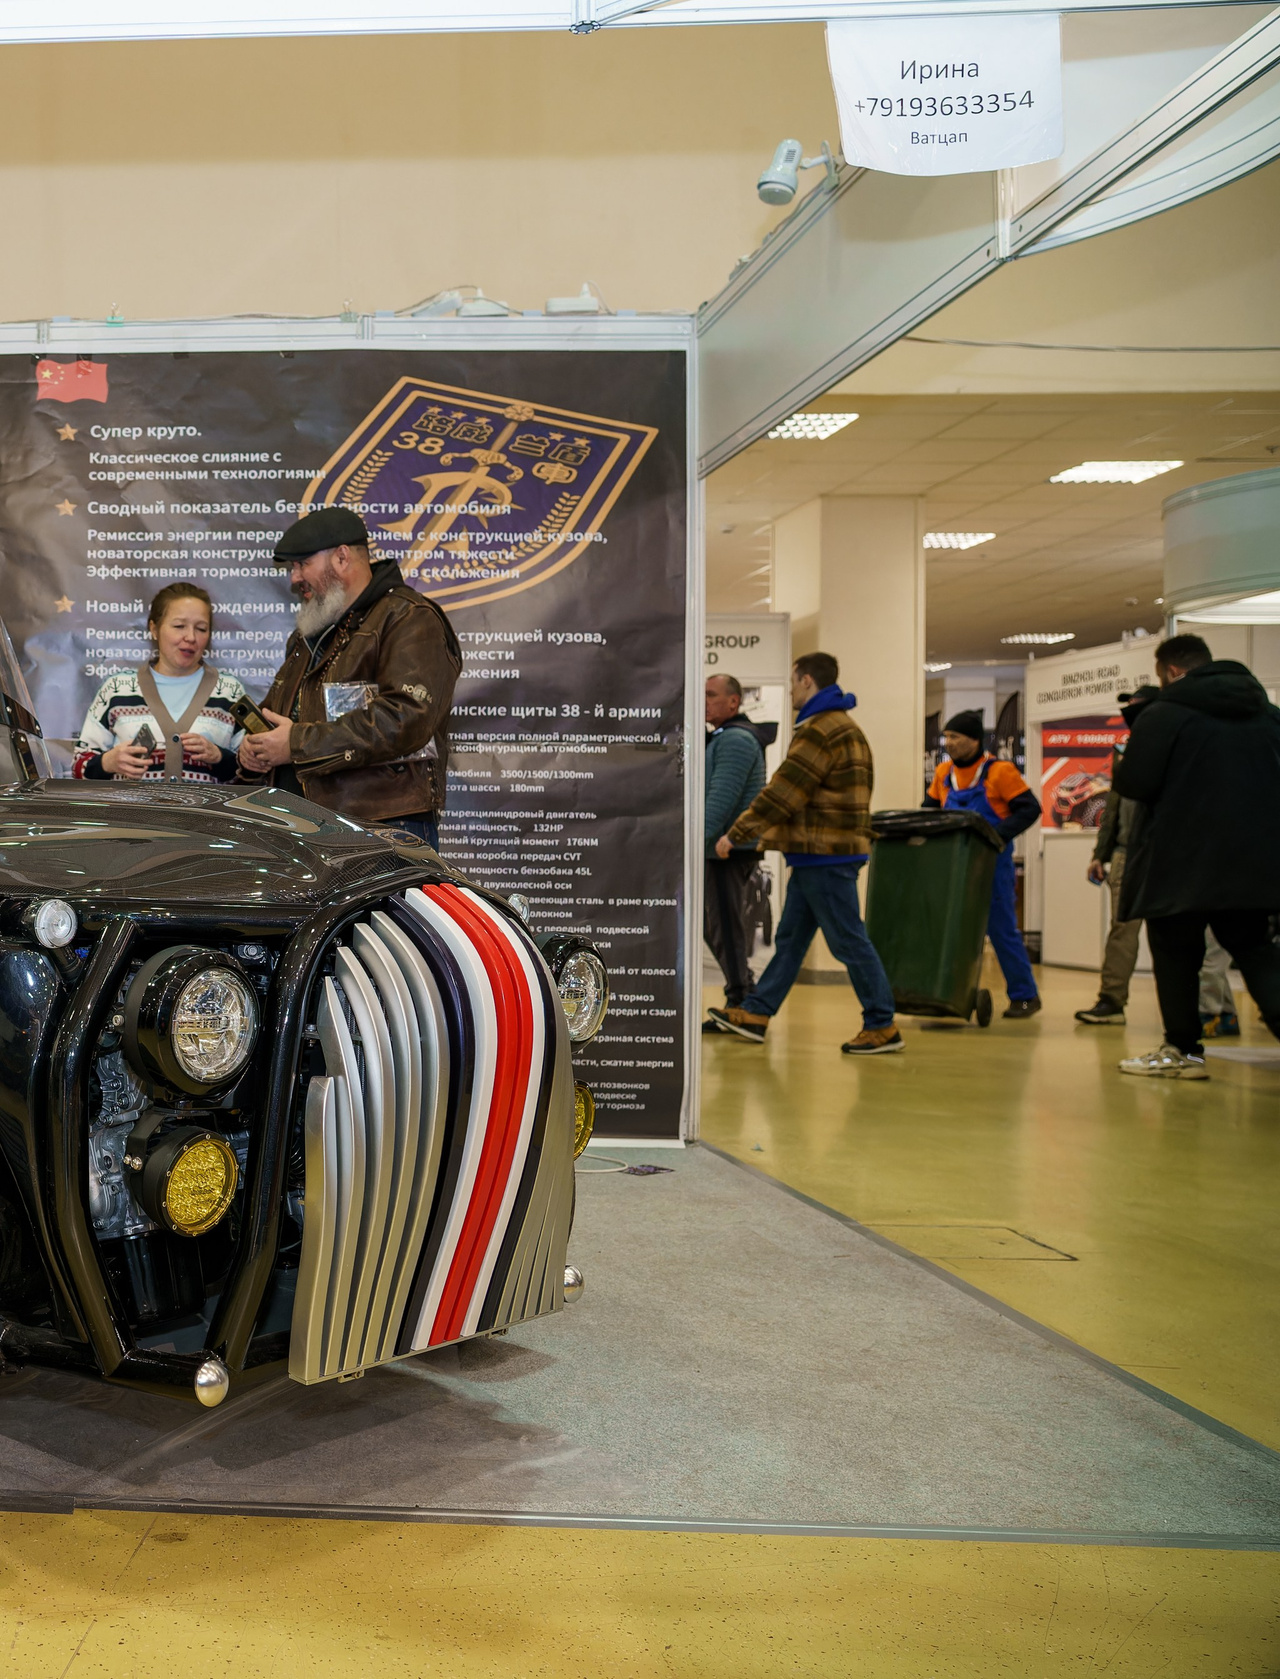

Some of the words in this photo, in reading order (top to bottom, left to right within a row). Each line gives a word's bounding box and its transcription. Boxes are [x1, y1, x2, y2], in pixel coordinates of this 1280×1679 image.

[900, 60, 980, 84] Ирина
[854, 90, 1035, 117] +79193633354
[910, 131, 968, 146] Ватцап
[90, 425, 143, 440] Супер
[147, 425, 202, 440] круто.
[392, 431, 445, 456] 38
[89, 452, 199, 464] Классическое
[202, 452, 270, 464] слияние
[273, 452, 282, 463] с
[88, 470, 209, 482] современными
[212, 469, 327, 480] технологиями
[87, 501, 166, 517] Сводный
[170, 503, 271, 515] показатель
[275, 499, 399, 515] безопности
[403, 501, 511, 515] автомобиля
[87, 529, 164, 542] Ремиссия
[167, 531, 233, 544] энергии
[417, 531, 426, 541] с
[430, 529, 544, 545] конструкцией
[548, 530, 608, 544] кузова,
[87, 550, 188, 562] новаторская
[193, 550, 276, 562] конструкц
[375, 550, 444, 561] центром
[449, 550, 516, 561] тяжести
[86, 564, 197, 580] Эффективная
[201, 567, 288, 579] тормозная
[422, 567, 520, 579] скольжения
[86, 599, 144, 613] Новый
[86, 628, 153, 640] Ремисси
[235, 631, 283, 643] перед
[457, 630, 543, 645] струкцией
[547, 632, 607, 645] кузова,
[401, 684, 428, 699] ROUTE
[450, 705, 507, 717] инские
[511, 706, 557, 720] щиты
[561, 704, 580, 718] 38
[594, 704, 604, 718] й
[608, 706, 662, 721] армии
[476, 732, 516, 742] версия
[518, 732, 560, 742] полной
[562, 732, 661, 744] параметрической
[540, 743, 608, 755] автомобиля
[447, 769, 492, 779] омобиля
[500, 769, 594, 780] 3500/1500/1300mm
[470, 784, 501, 793] шасси
[509, 783, 545, 793] 180mm
[545, 811, 597, 820] двигатель
[533, 823, 564, 833] 132HP
[470, 836, 520, 847] крутящий
[522, 838, 560, 847] момент
[566, 837, 599, 847] 176NM
[476, 851, 519, 861] коробка
[521, 853, 562, 863] передач
[563, 852, 582, 862] CVT
[469, 866, 519, 876] мощность
[521, 865, 574, 876] бензобака
[574, 866, 593, 876] 45L
[483, 880, 553, 891] двухколесной
[554, 882, 572, 890] оси
[575, 897, 604, 906] сталь
[608, 898, 615, 906] в
[616, 898, 641, 908] раме
[642, 898, 678, 908] кузова
[528, 910, 573, 919] олокном
[596, 925, 650, 936] подвеской
[627, 967, 640, 976] от
[641, 967, 676, 976] колеса
[619, 993, 655, 1003] тормоз
[640, 1008, 648, 1016] и
[649, 1008, 677, 1018] сзади
[635, 1035, 674, 1044] система
[600, 1058, 634, 1067] сжатие
[635, 1059, 674, 1069] энергии
[599, 1081, 651, 1091] позвонков
[593, 1091, 638, 1101] подвеске
